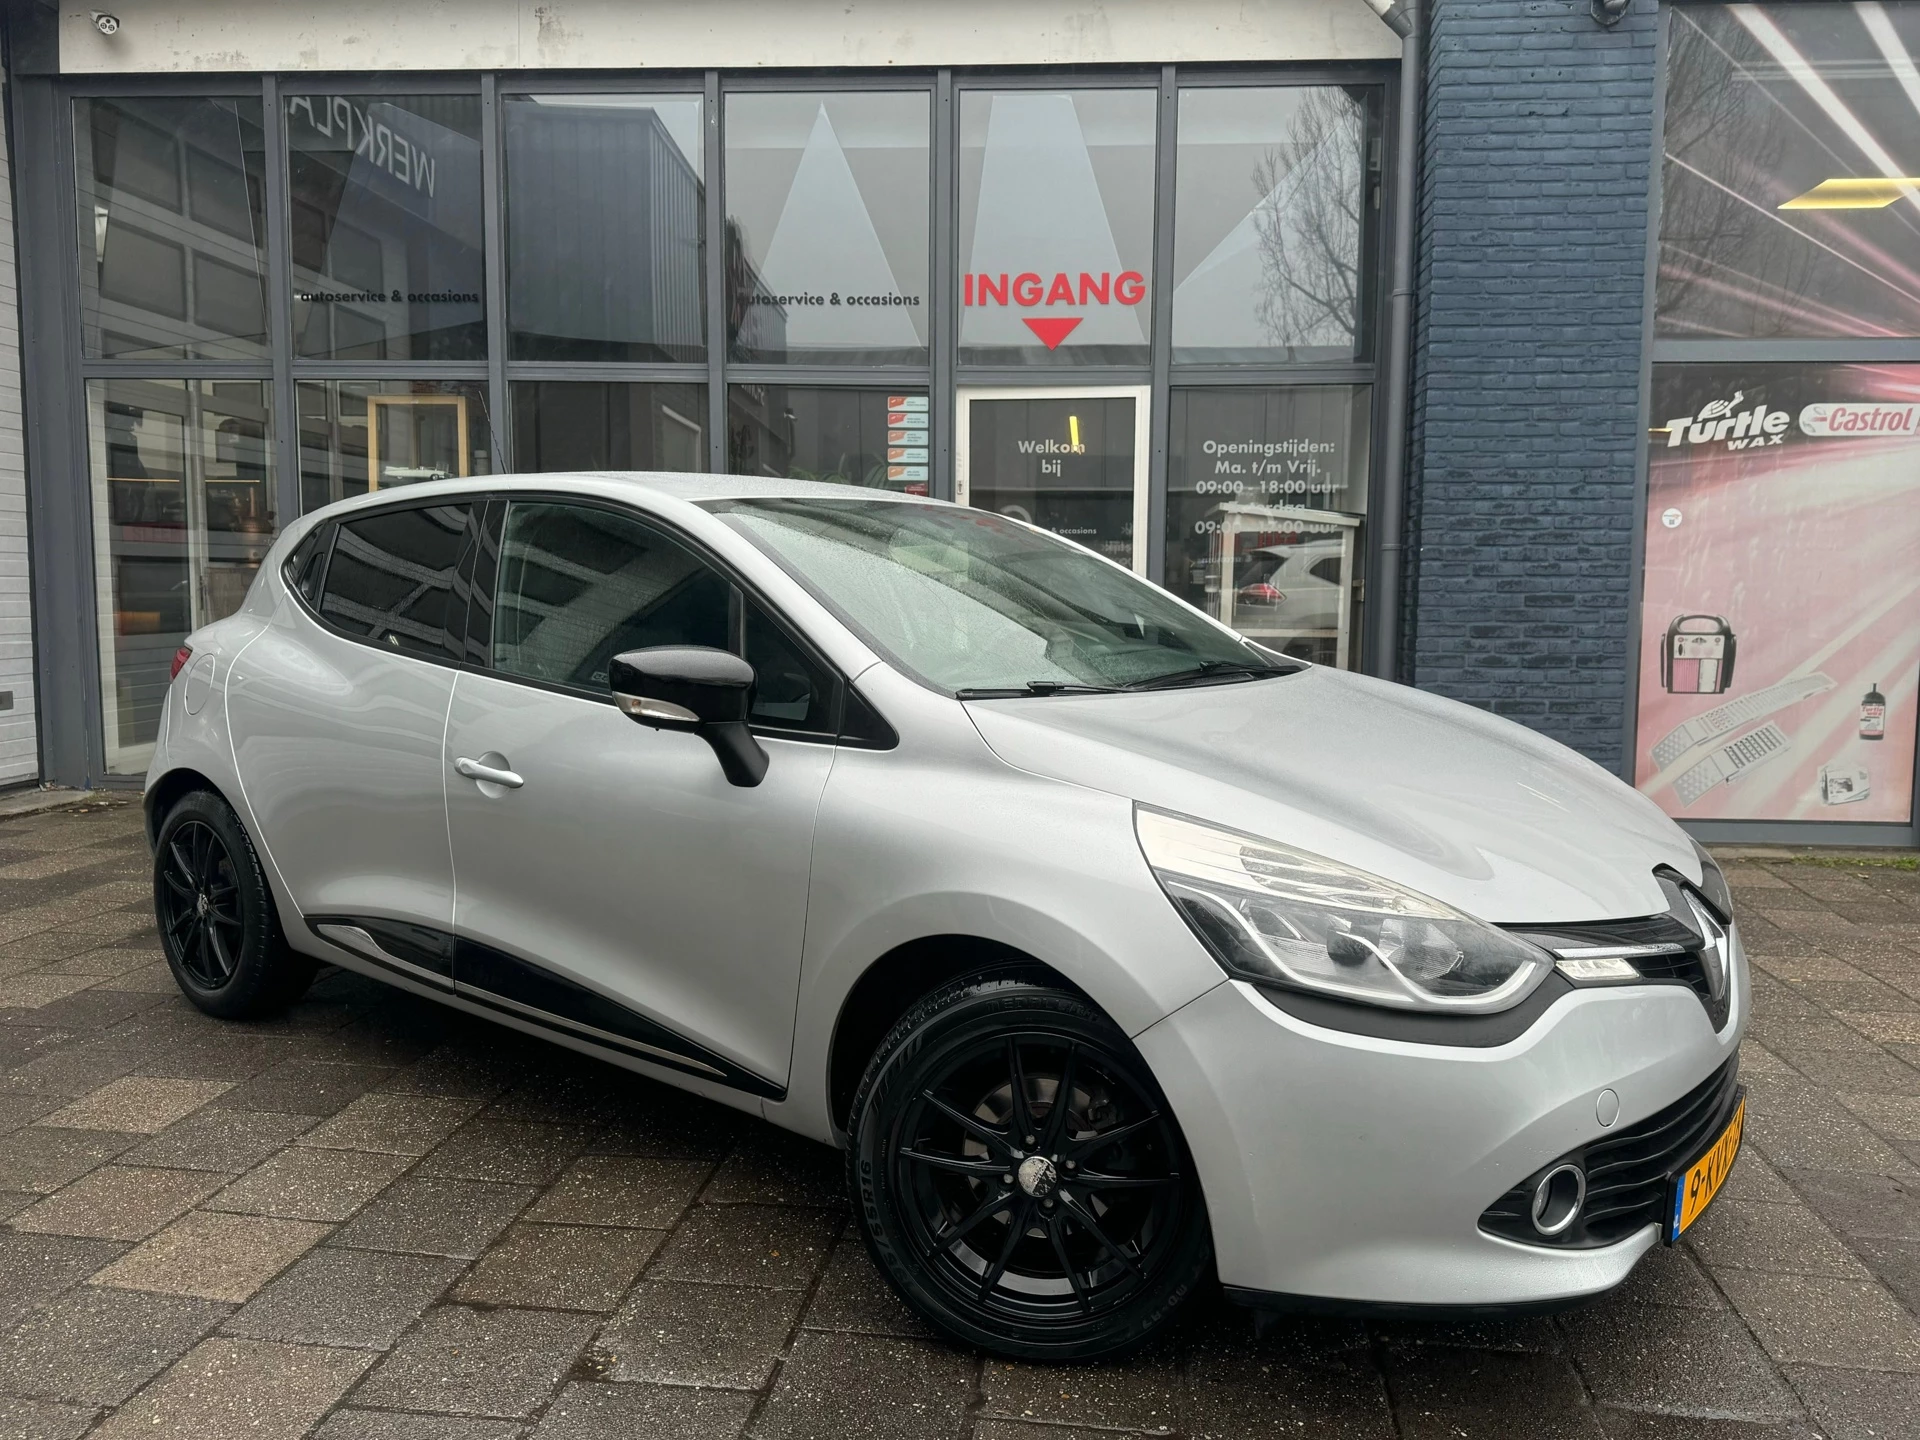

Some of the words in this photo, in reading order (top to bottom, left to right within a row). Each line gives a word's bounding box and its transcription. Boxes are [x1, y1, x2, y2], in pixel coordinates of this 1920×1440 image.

[301, 289, 386, 304] autoservice
[391, 290, 402, 303] &
[407, 290, 479, 303] occasions
[964, 271, 1146, 307] INGANG
[738, 291, 824, 306] utoservice
[829, 294, 842, 306] &
[847, 293, 920, 306] occasions
[1667, 405, 1790, 447] Turtle
[1828, 407, 1914, 432] Castrol
[1018, 439, 1085, 454] Welkom
[1203, 439, 1335, 457] Openingstijden:
[1727, 435, 1784, 451] WAX
[1042, 460, 1061, 477] bij
[1215, 460, 1247, 474] Ma.
[1252, 459, 1281, 476] t/m
[1287, 459, 1321, 477] Vrij.
[1196, 481, 1244, 494] 09:00
[1260, 480, 1306, 494] 18:00
[1311, 484, 1339, 494] uur
[1228, 499, 1306, 516] Zterdag
[1059, 526, 1097, 535] occasions
[1195, 521, 1242, 534] 09:00
[1689, 1100, 1742, 1217] 9-KVX-
